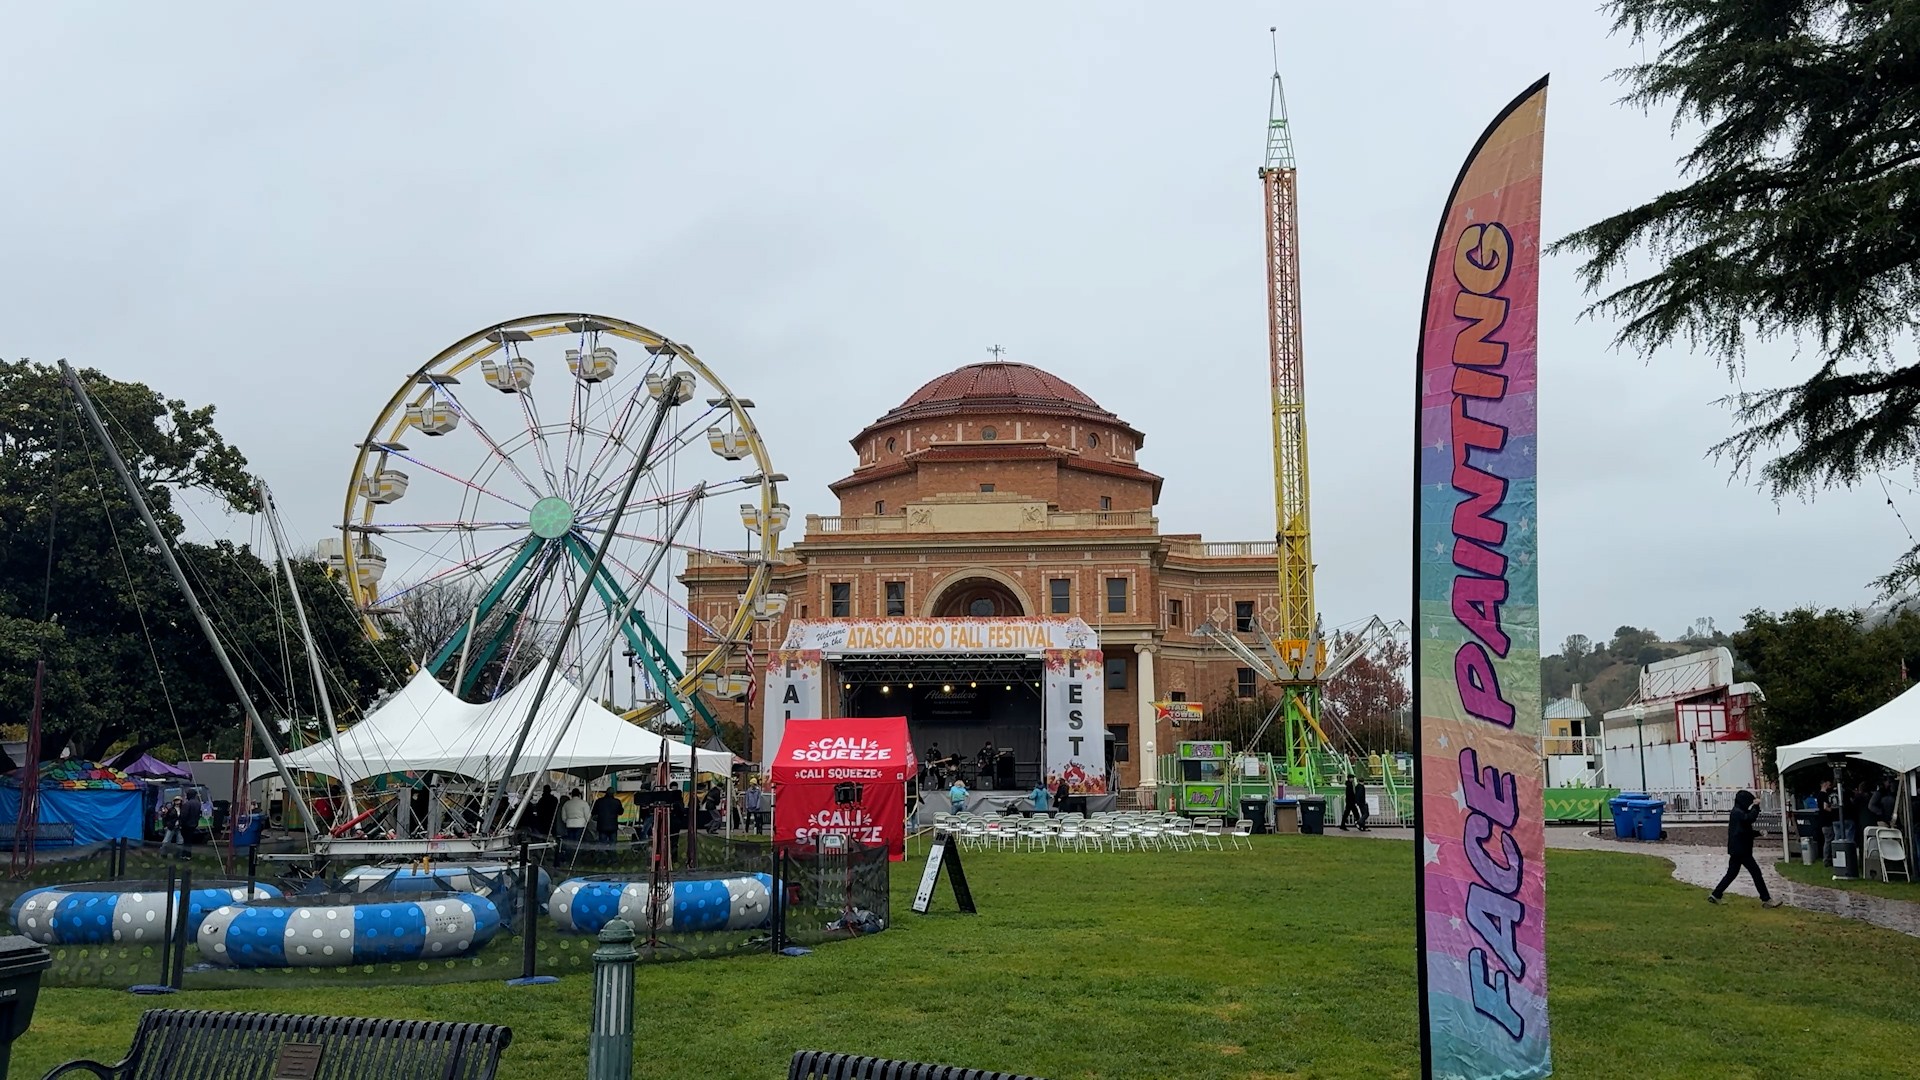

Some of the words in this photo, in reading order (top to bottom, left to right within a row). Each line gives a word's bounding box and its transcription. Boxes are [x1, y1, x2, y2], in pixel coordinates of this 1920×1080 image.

[1451, 222, 1515, 729] PAINTING
[816, 628, 846, 642] Welcome
[846, 626, 946, 649] ATASCADERO
[951, 626, 983, 648] FALL
[988, 626, 1054, 648] FESTIVAL
[822, 640, 830, 649] to
[831, 637, 843, 646] the
[1068, 658, 1084, 756] FEST
[1165, 703, 1187, 711] STAR
[1169, 711, 1201, 719] TOWER
[819, 737, 867, 750] CALI
[791, 748, 892, 762] SQUEEZE
[800, 769, 824, 779] CALI
[828, 768, 878, 779] SQUEEZE
[817, 809, 862, 827] CALI
[1459, 747, 1525, 1040] FACE
